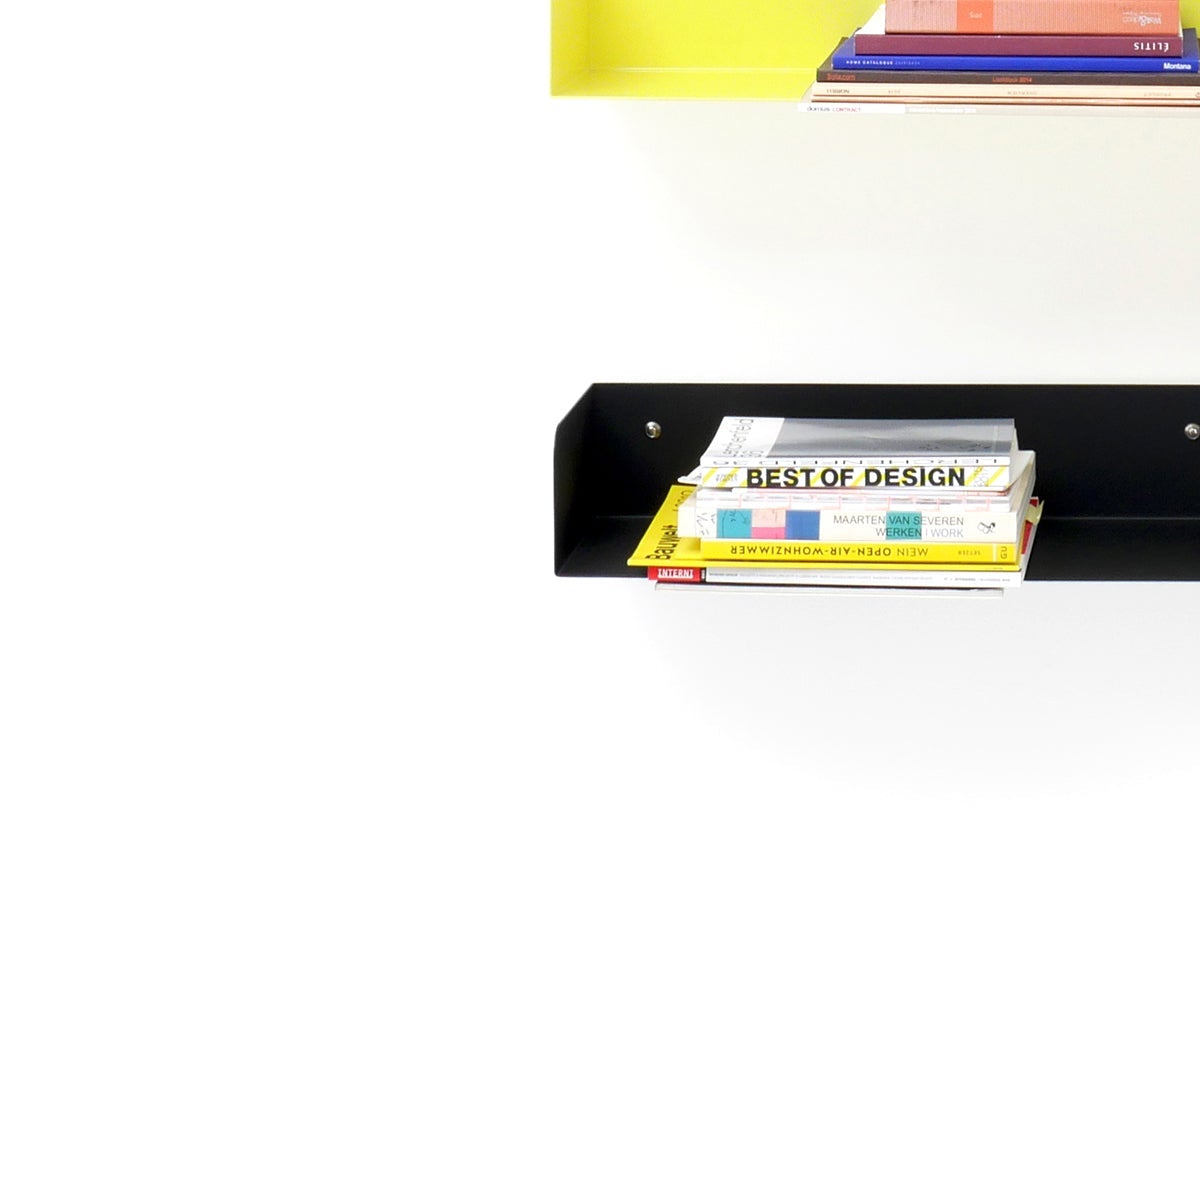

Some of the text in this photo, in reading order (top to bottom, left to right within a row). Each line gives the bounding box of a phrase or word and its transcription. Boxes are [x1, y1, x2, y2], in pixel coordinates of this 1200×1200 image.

[1132, 41, 1169, 52] ÉLITIS
[1163, 61, 1191, 71] Montana
[747, 468, 816, 487] BEST
[821, 468, 855, 487] OF
[864, 468, 965, 487] DESIGN
[833, 515, 965, 527] MAARTEN VAN SEVEREN
[875, 527, 964, 538] WERKEN WORK
[730, 545, 929, 557] MEIN OPEN-AIR-WOHNZIMMER
[657, 568, 694, 579] INTERNI
